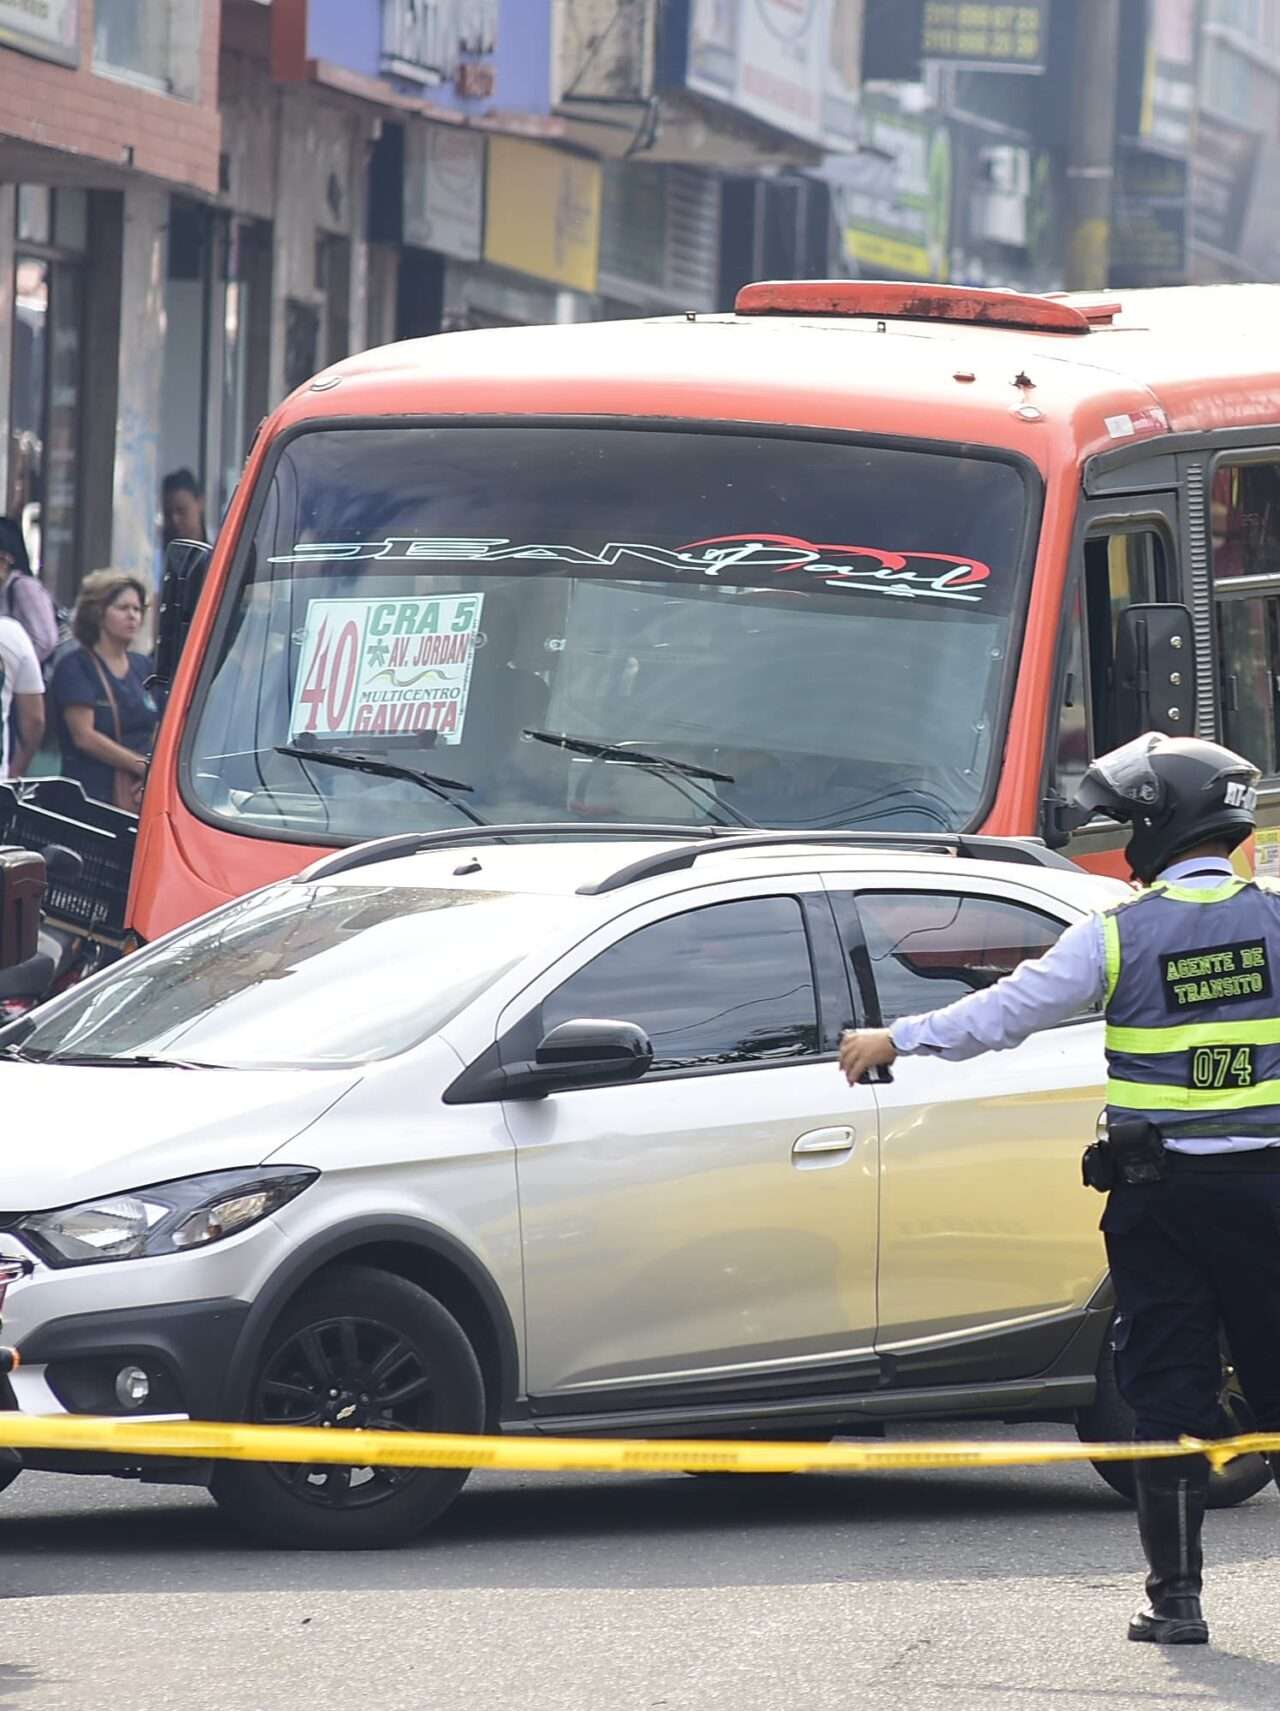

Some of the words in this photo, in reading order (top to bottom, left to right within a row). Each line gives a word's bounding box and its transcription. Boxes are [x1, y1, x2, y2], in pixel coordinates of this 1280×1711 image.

[370, 602, 441, 637] CRA
[451, 601, 477, 633] 5
[388, 635, 410, 668] AV.
[413, 633, 472, 667] JORDAN
[300, 612, 359, 733] 40
[360, 687, 461, 704] MULTICENTRO
[354, 701, 458, 736] GAVIOTA
[1166, 951, 1236, 982] AGENTE
[1239, 946, 1266, 969] DE
[1173, 972, 1264, 1005] TRANSITO
[1193, 1047, 1252, 1088] 074
